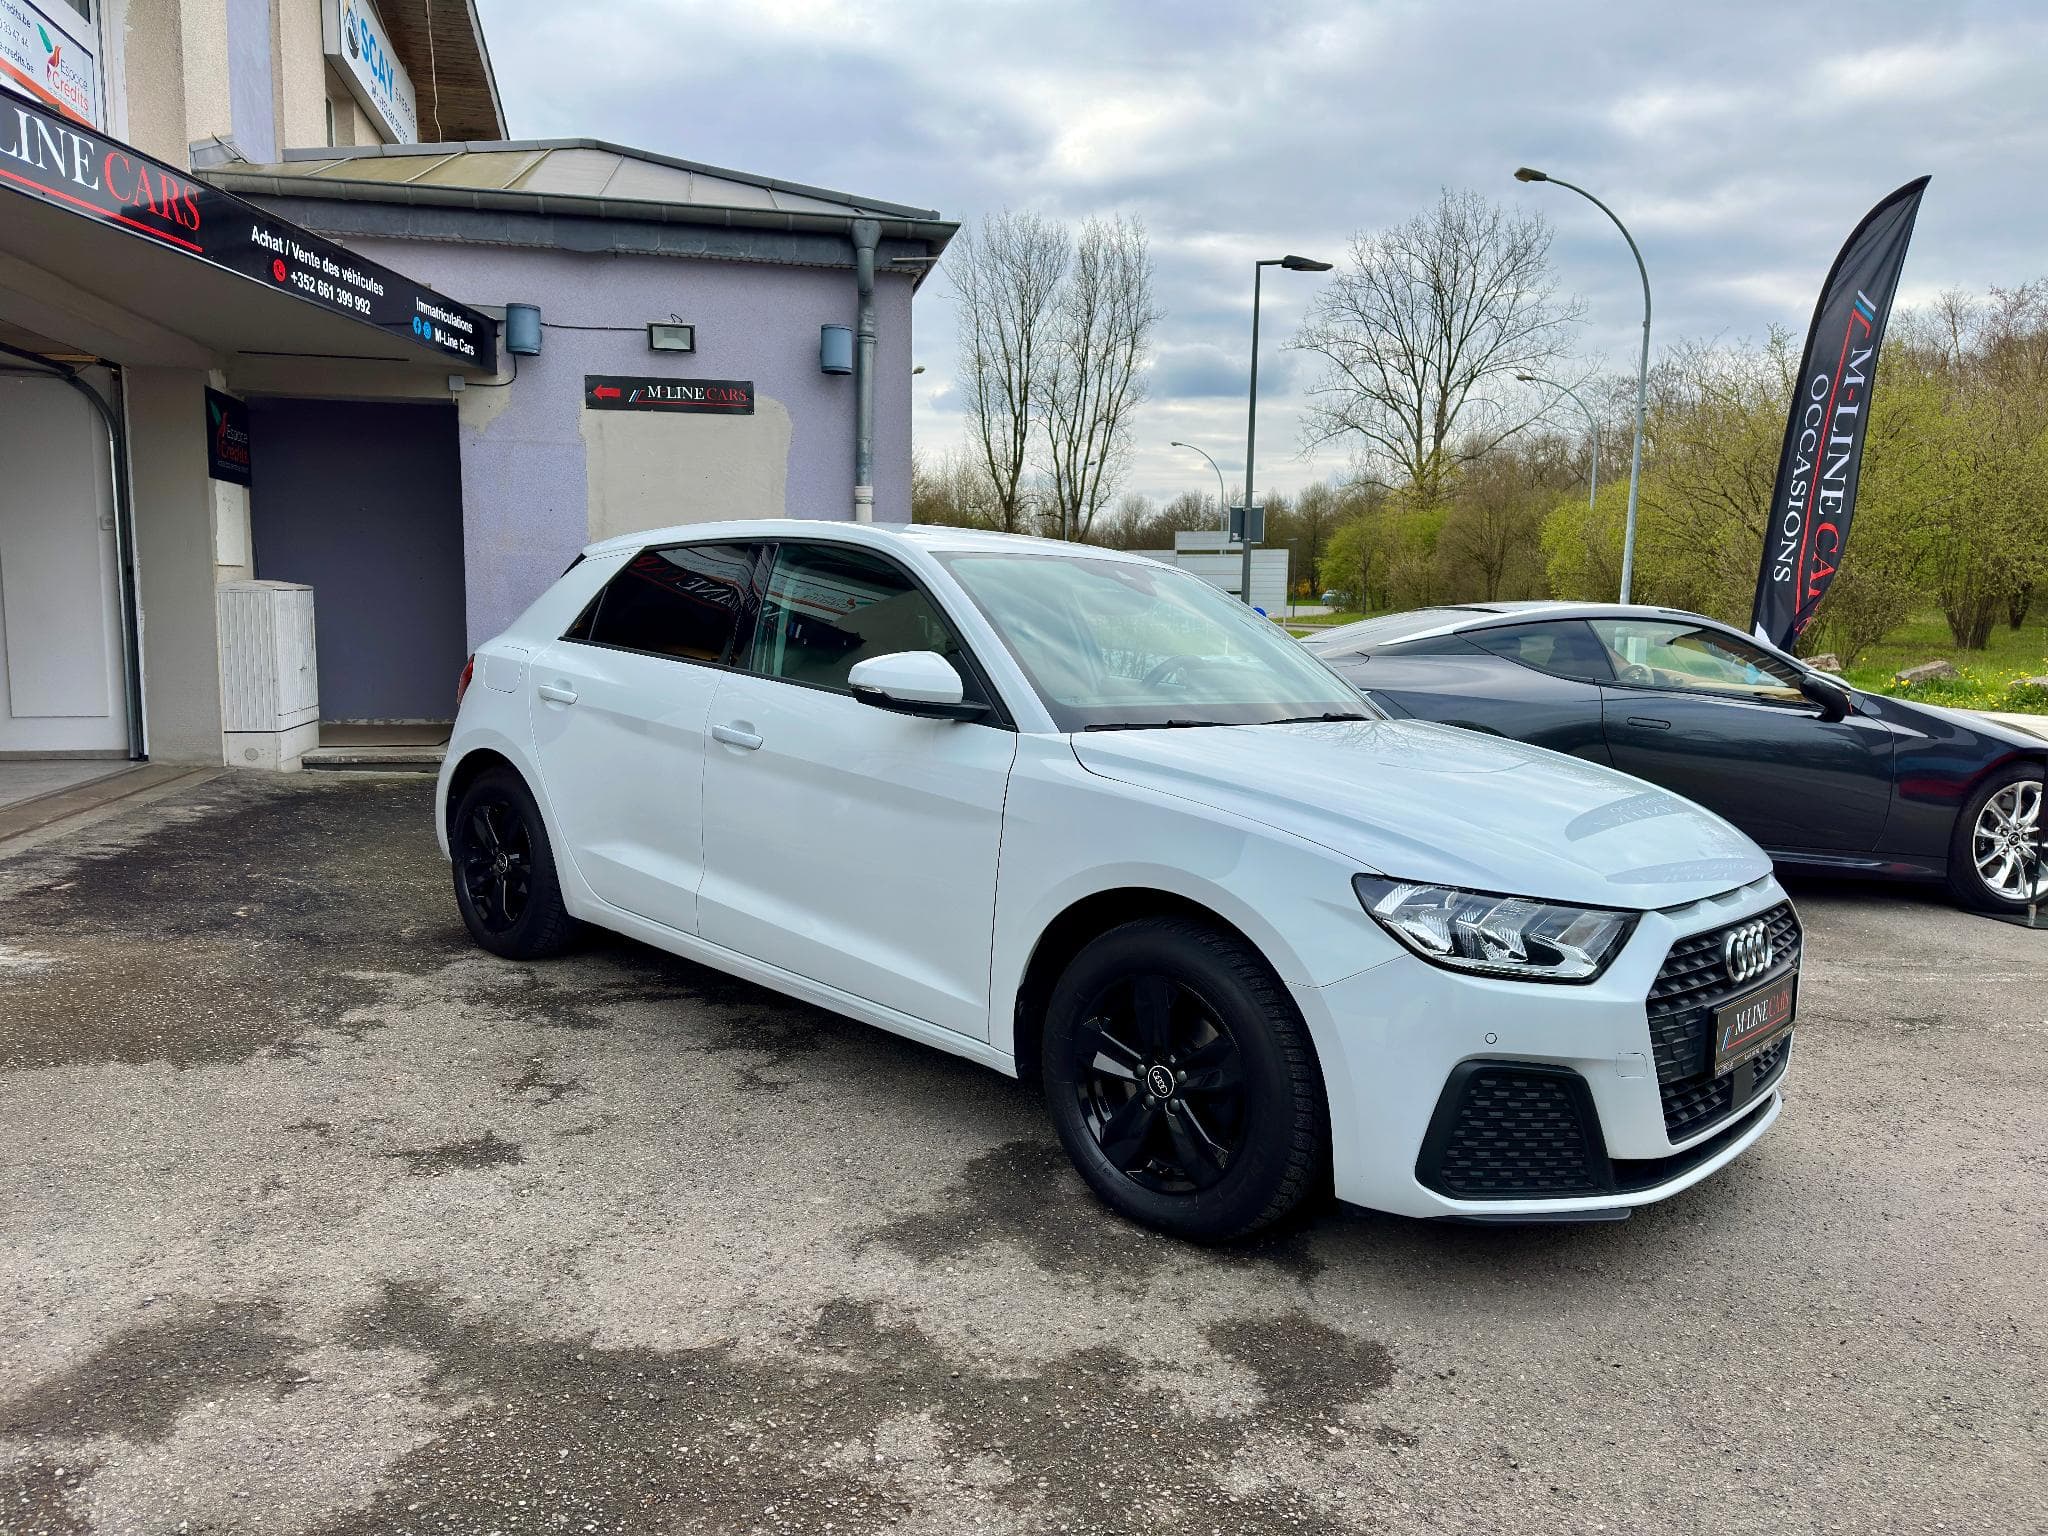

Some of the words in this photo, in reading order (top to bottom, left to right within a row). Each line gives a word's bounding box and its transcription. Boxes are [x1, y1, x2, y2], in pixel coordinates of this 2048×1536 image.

[360, 18, 394, 102] SCAY
[104, 152, 200, 231] CARS
[251, 225, 283, 255] Achat
[291, 242, 320, 268] Vente
[322, 258, 340, 278] des
[342, 267, 384, 297] véhicules
[290, 271, 316, 293] +352
[317, 280, 335, 301] 661
[336, 288, 353, 308] 399
[354, 295, 371, 315] 992
[416, 296, 473, 334] Immatriculations
[434, 328, 458, 351] M-Line
[459, 338, 475, 356] Cars
[706, 387, 747, 402] CARS
[1818, 344, 1874, 515] M-LINE
[1773, 374, 1829, 582] OCCASIONS
